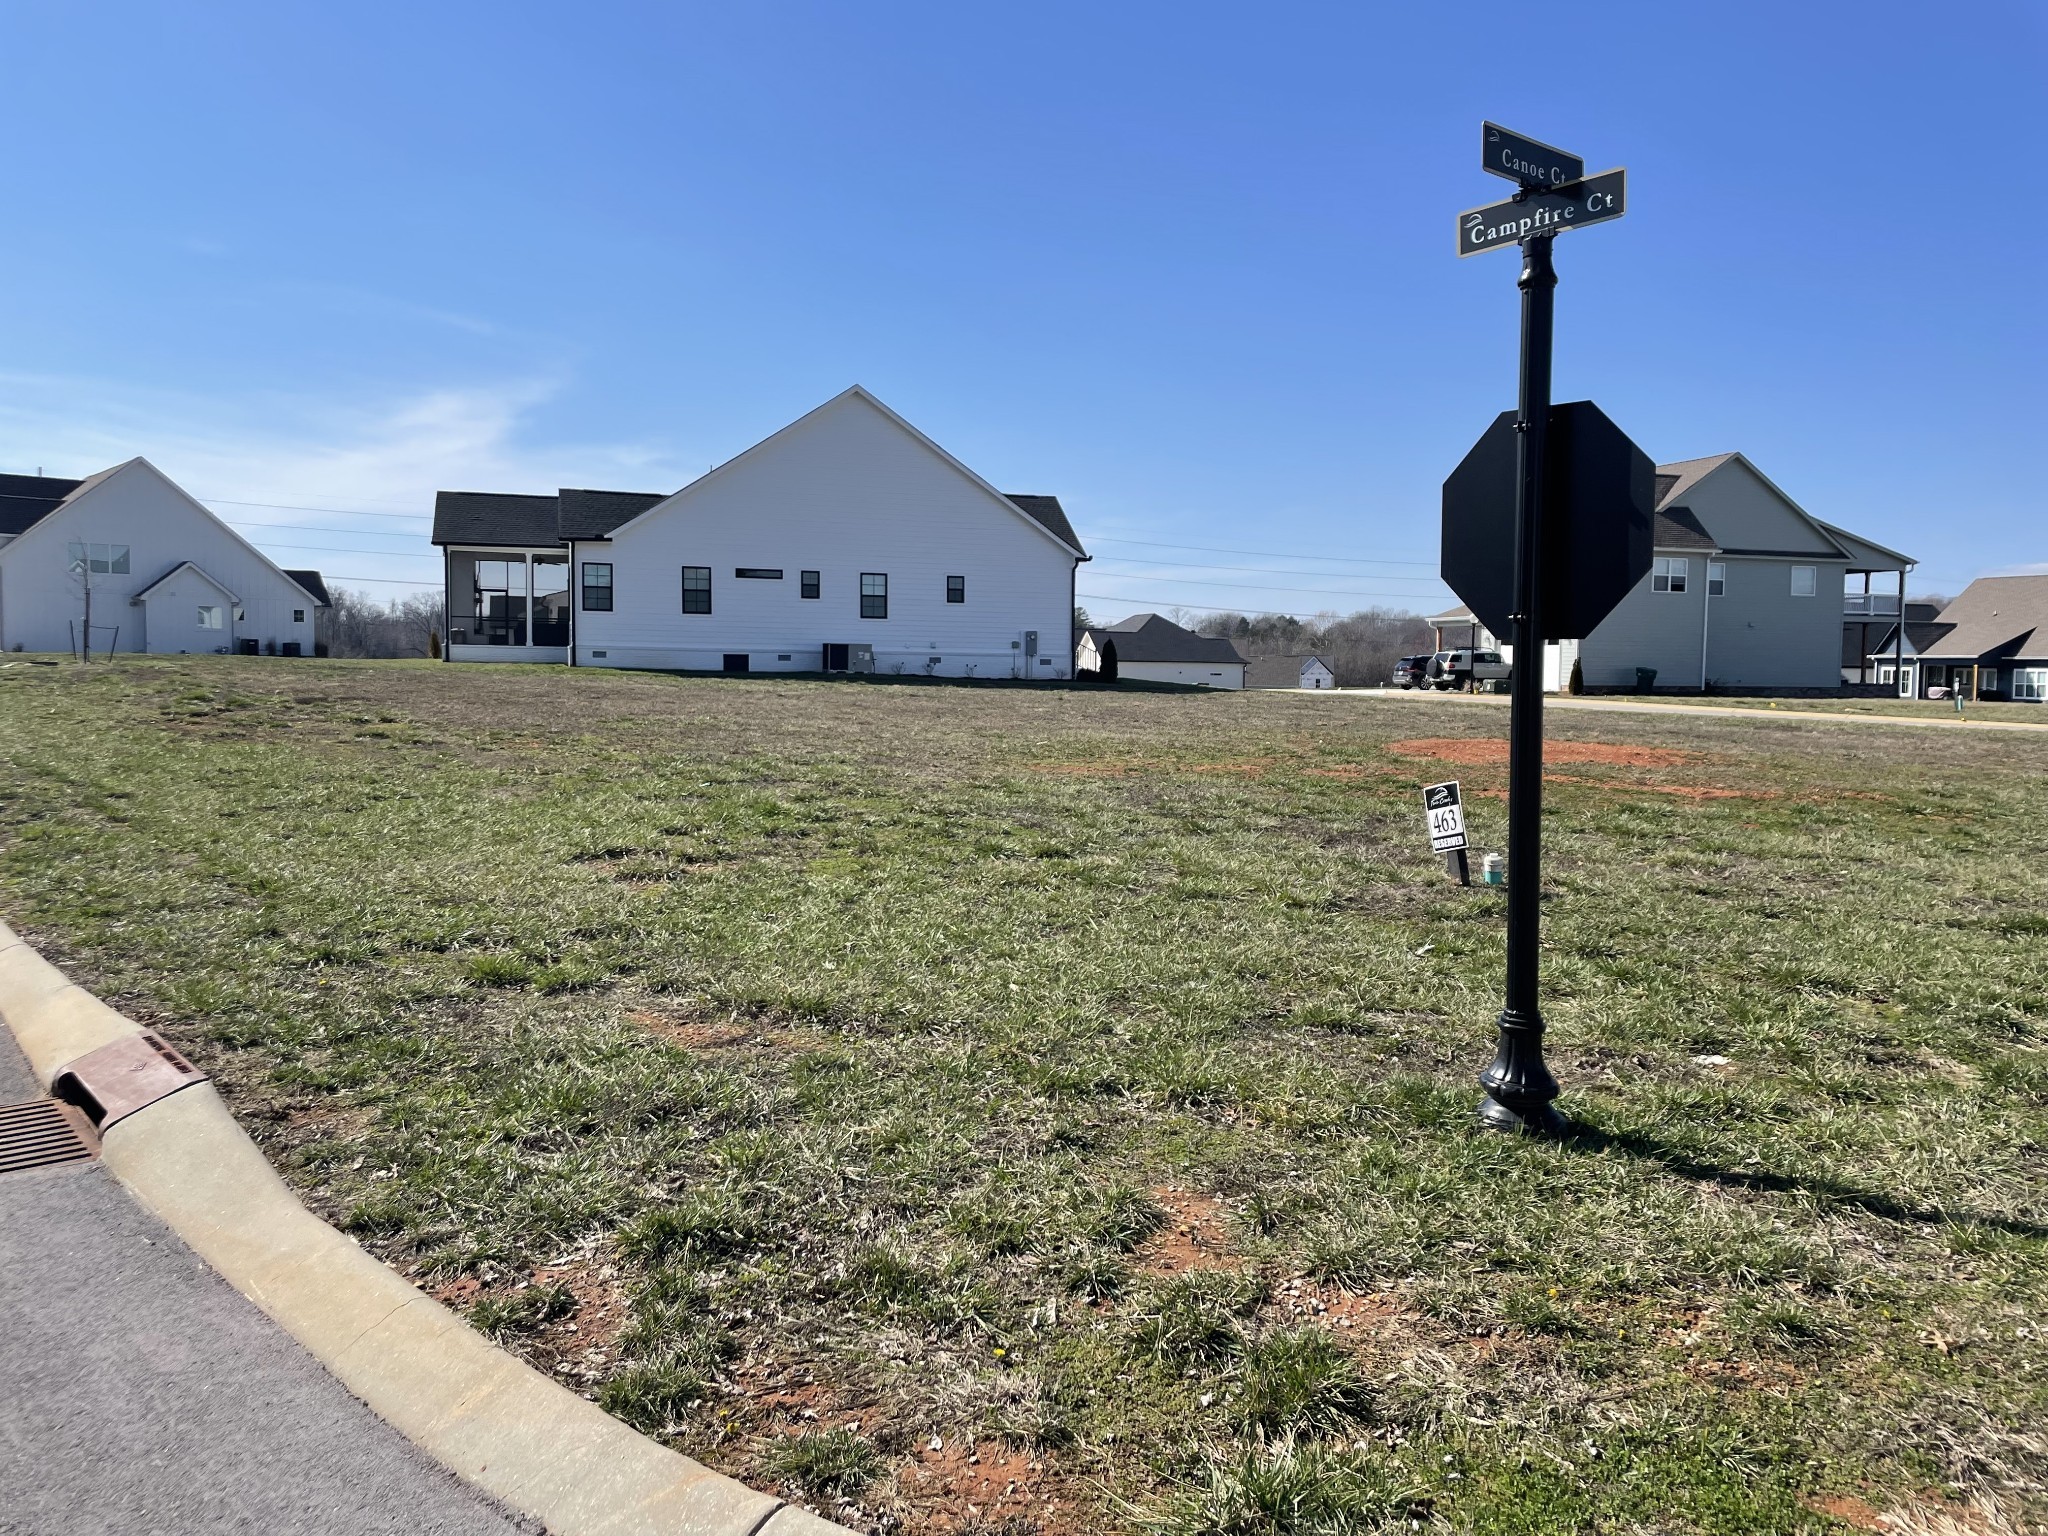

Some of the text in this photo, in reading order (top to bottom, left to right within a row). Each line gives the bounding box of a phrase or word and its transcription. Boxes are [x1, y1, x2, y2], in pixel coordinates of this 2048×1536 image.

[1502, 149, 1566, 184] Canoe Ct
[1471, 192, 1614, 244] Campfire Ct
[1434, 809, 1457, 833] 463
